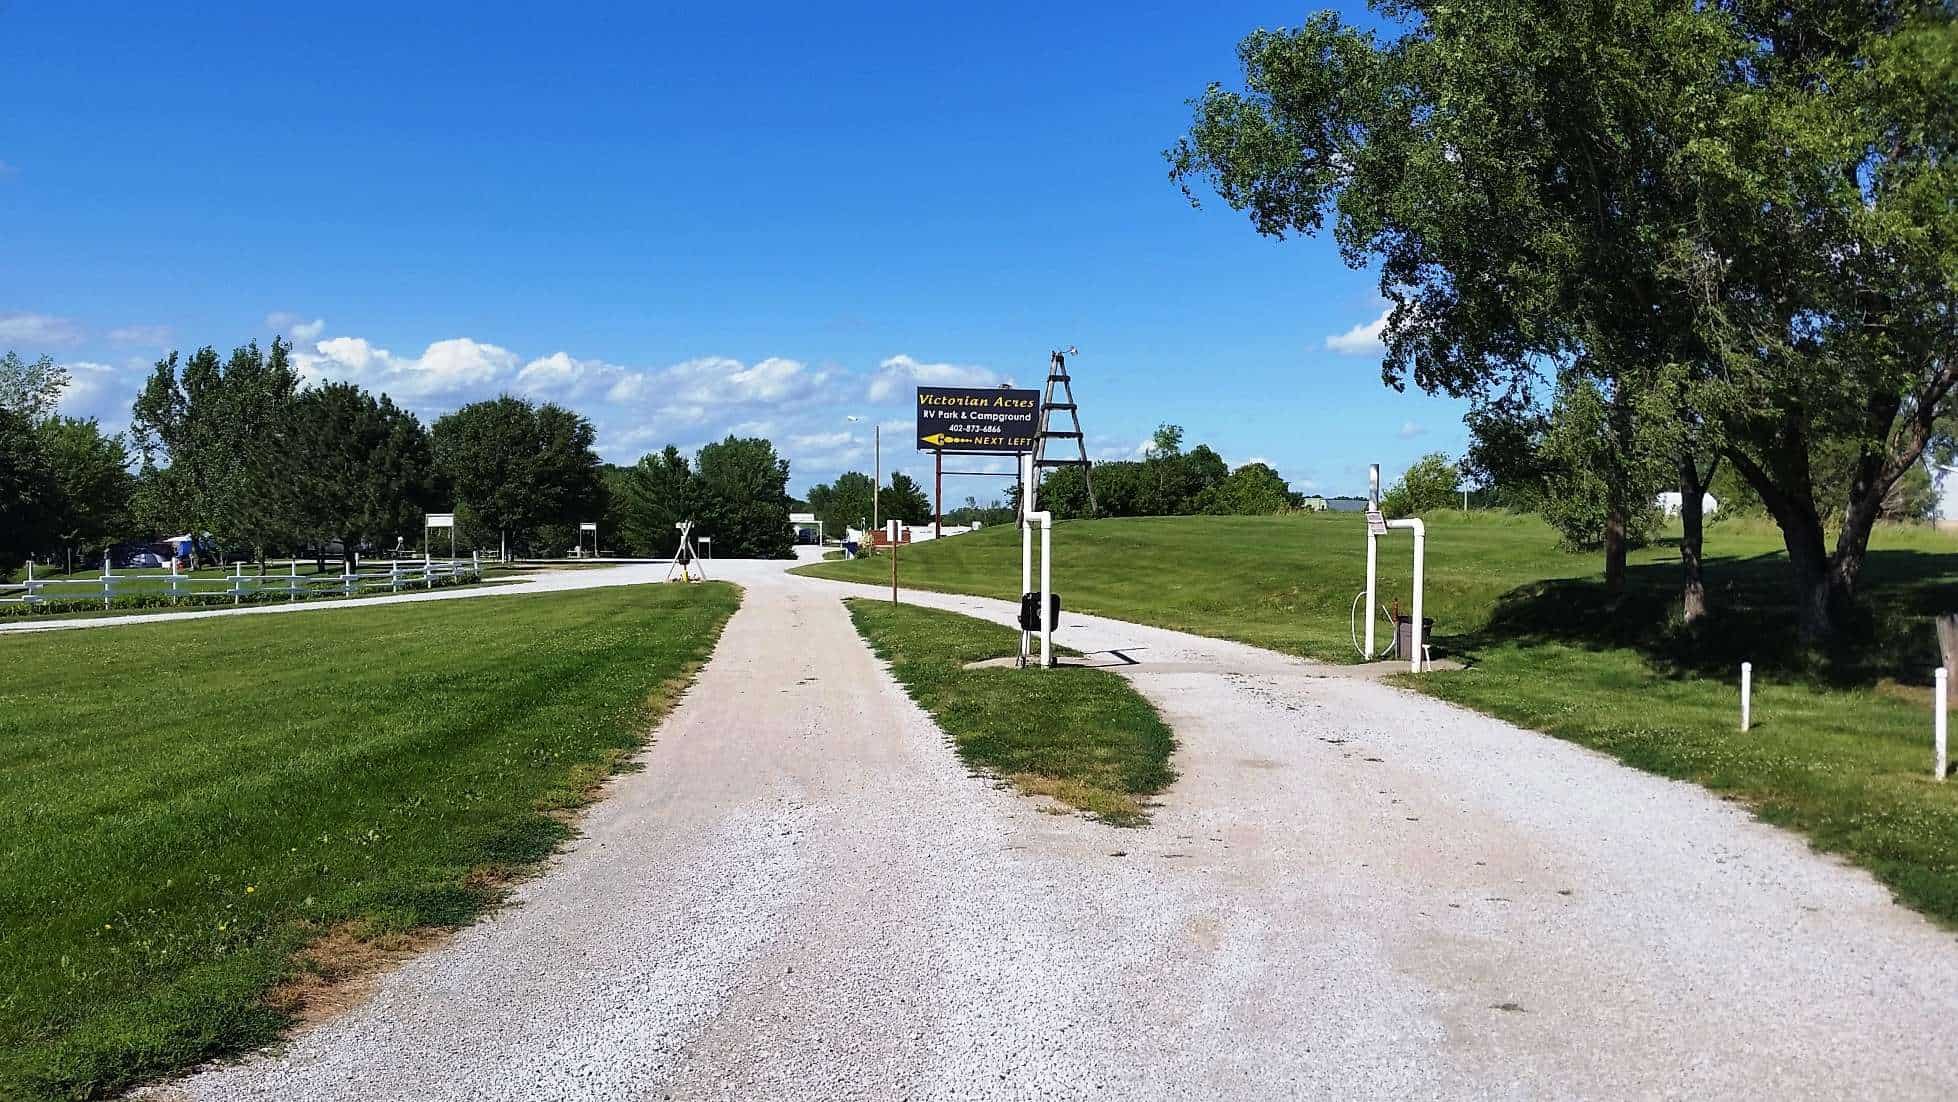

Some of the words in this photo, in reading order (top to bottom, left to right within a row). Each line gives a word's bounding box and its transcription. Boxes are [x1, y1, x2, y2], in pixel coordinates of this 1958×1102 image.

[919, 394, 988, 406] Victorian
[993, 396, 1034, 408] Acres
[923, 410, 935, 419] RV
[938, 410, 958, 419] Park
[961, 411, 967, 419] &
[970, 411, 1032, 422] Campground
[974, 436, 1004, 445] NEXT
[1008, 437, 1032, 446] LEFT
